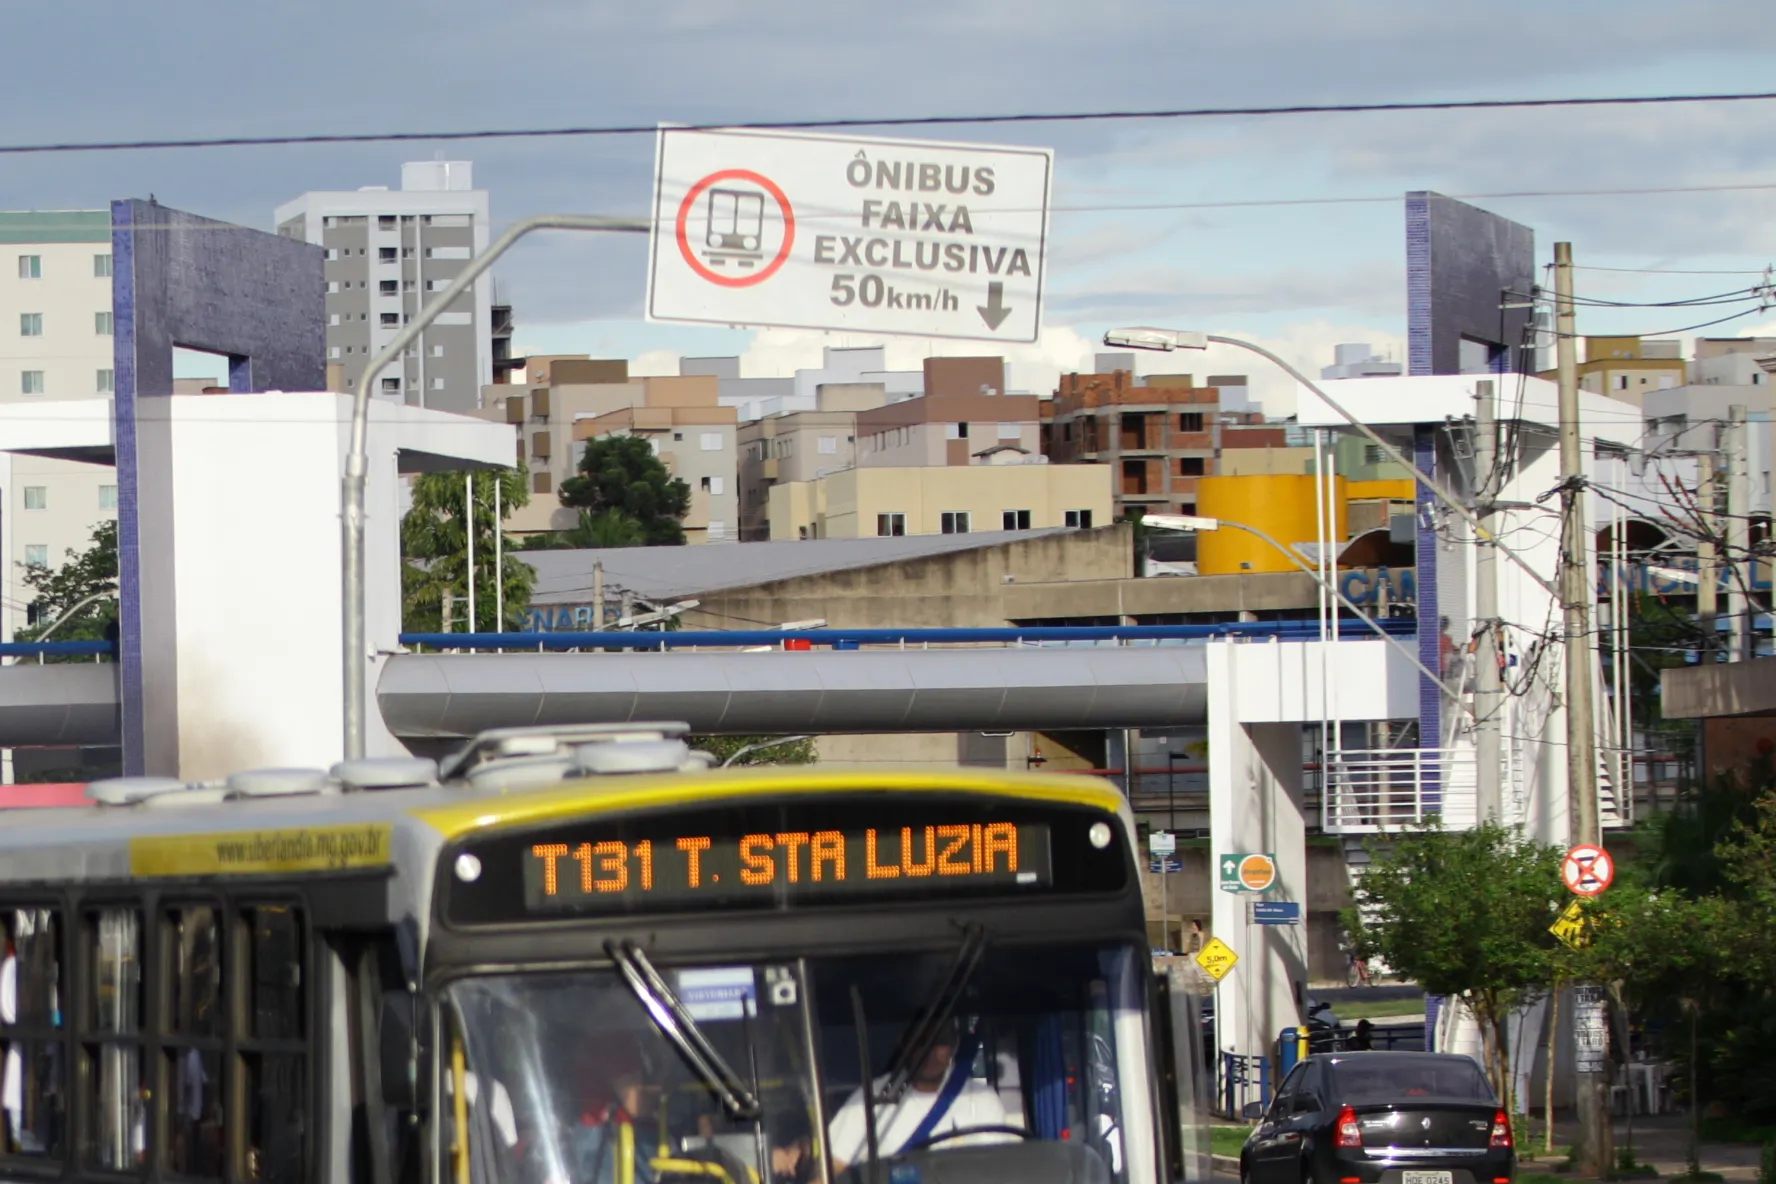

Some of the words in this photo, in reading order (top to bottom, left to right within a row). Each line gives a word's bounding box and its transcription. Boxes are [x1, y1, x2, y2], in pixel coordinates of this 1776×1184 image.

[846, 149, 996, 196] ÔNIBUS
[861, 200, 974, 235] FAIXA
[814, 235, 1033, 277] EXCLUSIVA
[532, 839, 652, 895] T131
[676, 836, 720, 889] T.
[739, 830, 846, 885] STA
[865, 822, 1018, 880] LUZIA
